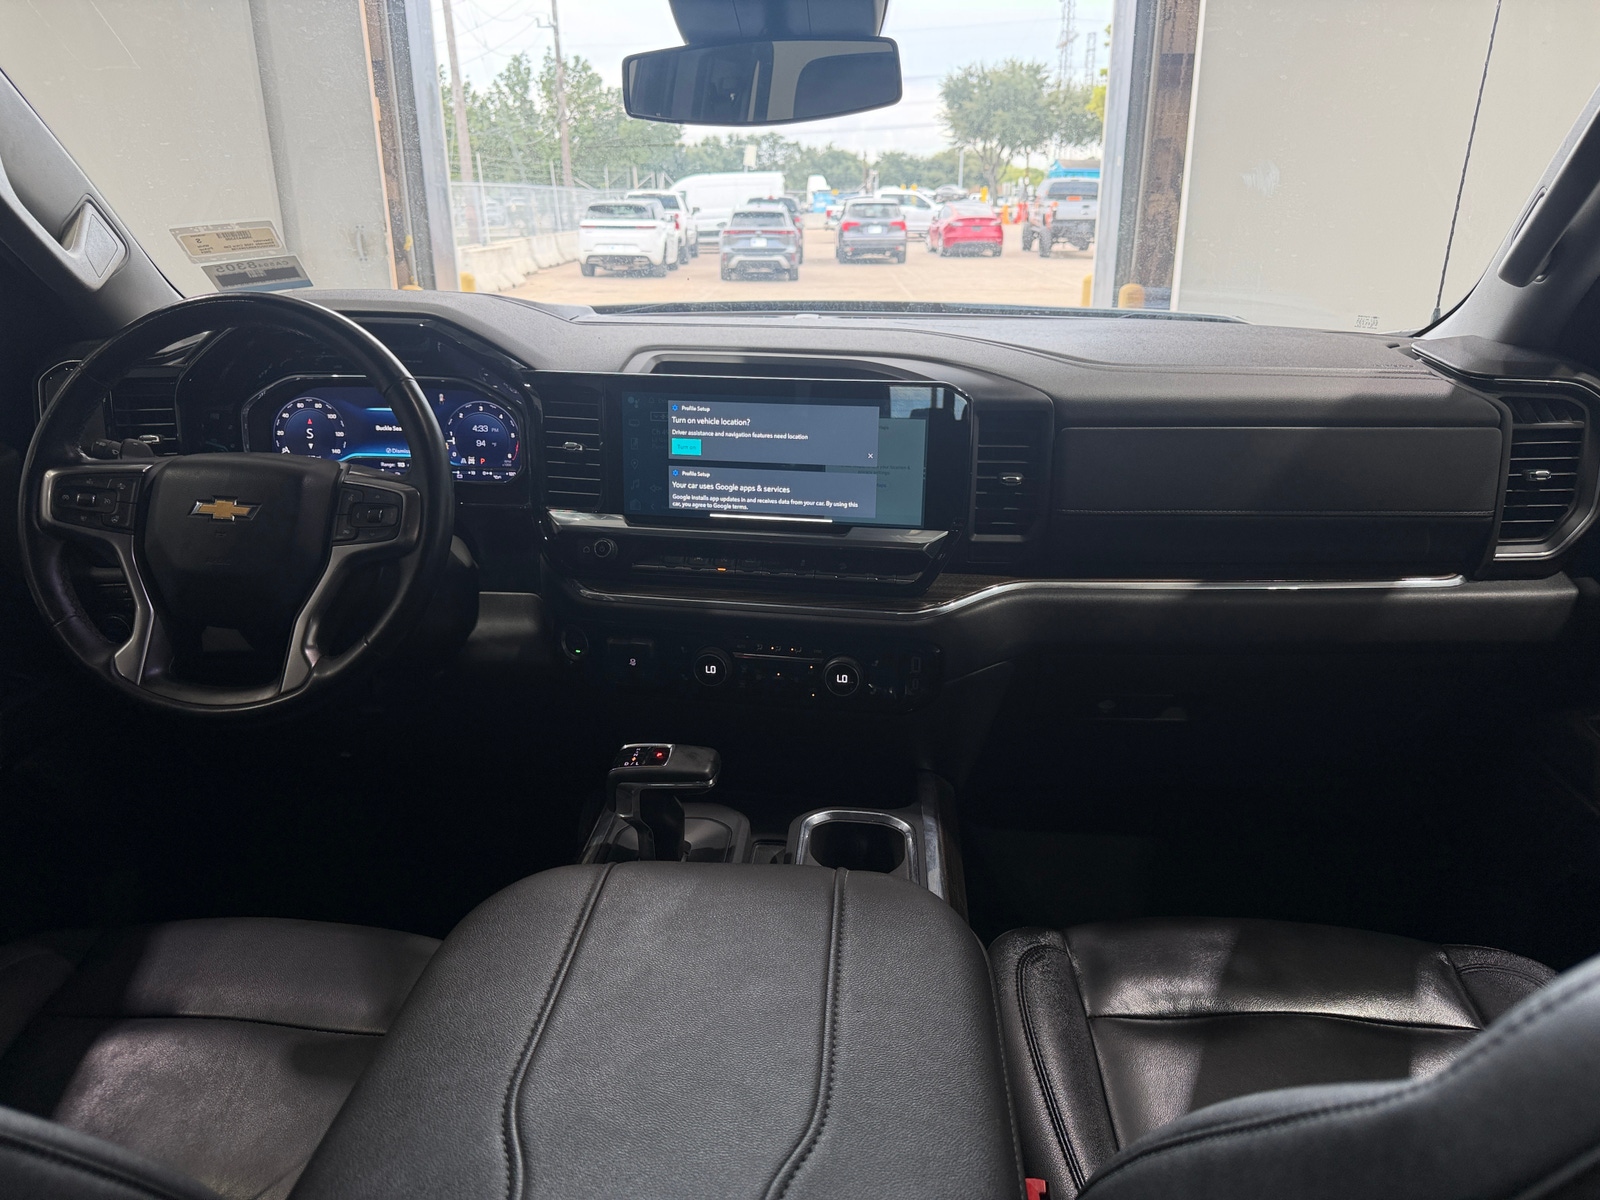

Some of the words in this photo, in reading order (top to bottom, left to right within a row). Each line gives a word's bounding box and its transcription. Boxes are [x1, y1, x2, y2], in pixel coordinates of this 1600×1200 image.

[672, 416, 686, 424] Turn
[721, 418, 750, 426] location?
[306, 428, 314, 439] S
[672, 481, 687, 489] Your
[715, 483, 739, 492] Google
[740, 485, 756, 493] apps
[713, 502, 731, 510] Google
[705, 665, 716, 674] LO
[837, 674, 848, 683] LO
